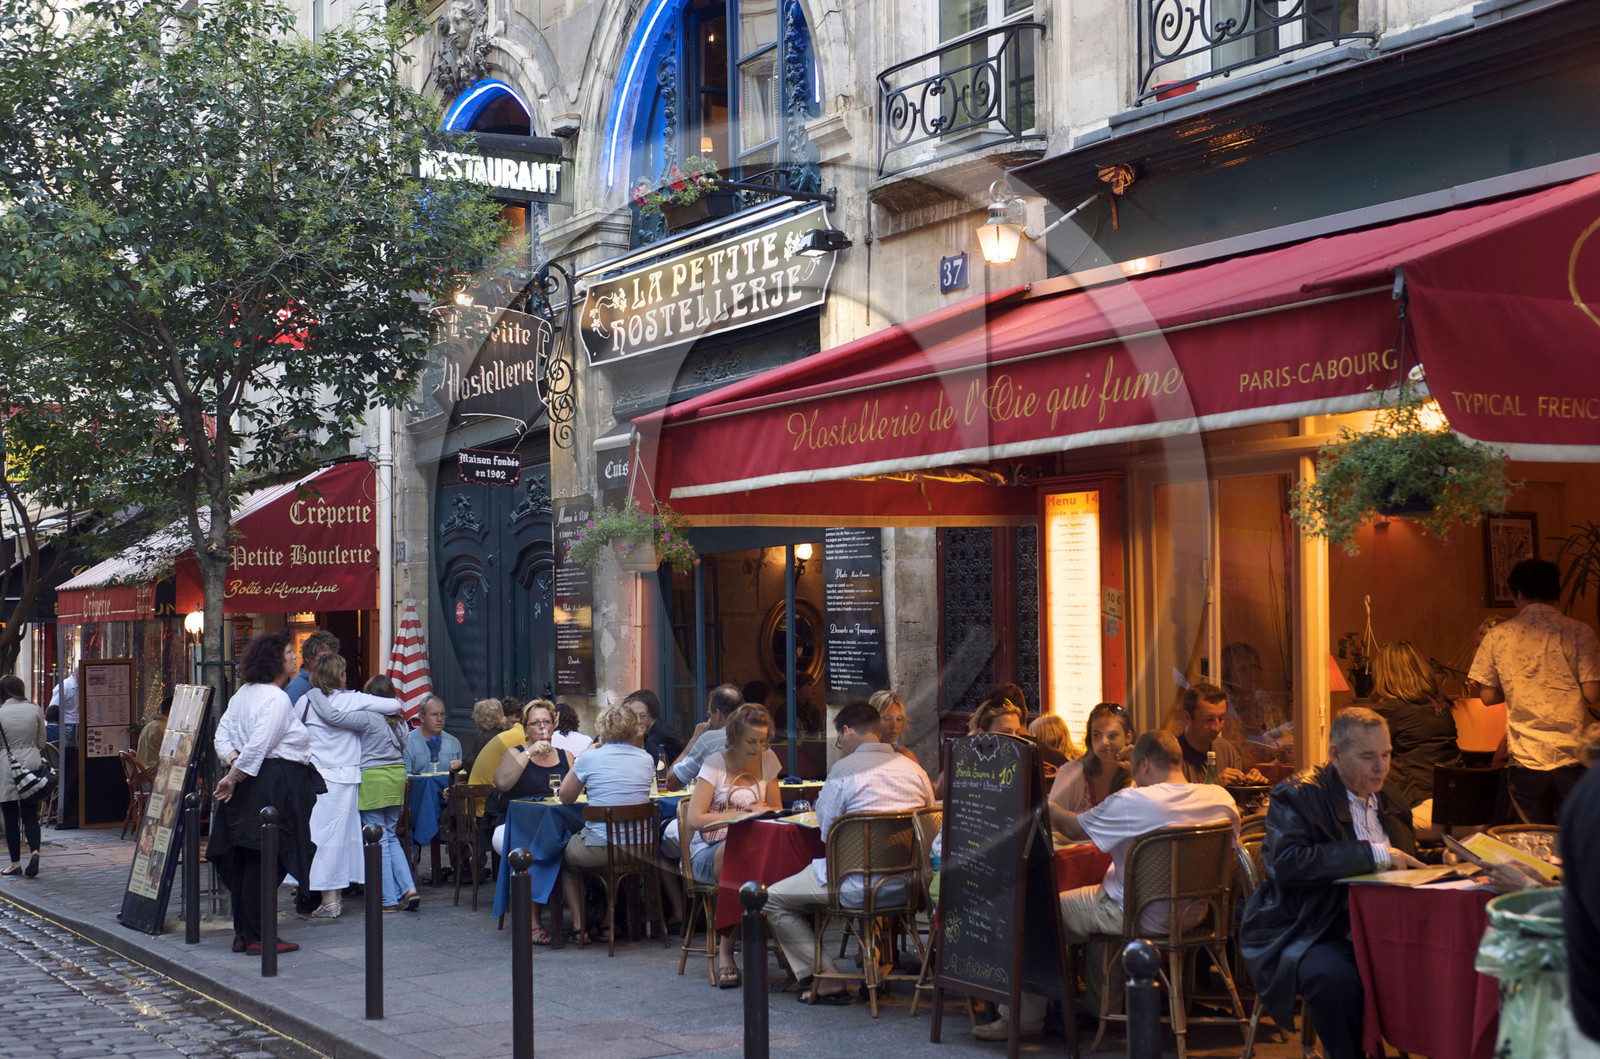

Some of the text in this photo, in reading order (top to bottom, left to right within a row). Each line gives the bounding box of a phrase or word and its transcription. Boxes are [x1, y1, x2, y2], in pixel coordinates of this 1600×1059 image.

[631, 231, 780, 310] LA PETITE
[943, 258, 963, 287] 37
[447, 358, 535, 403] Hostellerie
[1239, 348, 1398, 393] PARIS-CABOURG
[786, 397, 924, 452] Hostellerie
[928, 390, 958, 433] de
[1045, 372, 1095, 432] qui
[1098, 354, 1185, 425] fume
[1451, 390, 1526, 417] TYPICAL
[459, 452, 492, 465] Maison
[475, 469, 506, 480] en 1902
[289, 496, 372, 529] Crêperie
[1046, 495, 1077, 507] Menu
[228, 544, 372, 571] Petite Bouclerie
[223, 579, 340, 601] Bolée d'Armorique
